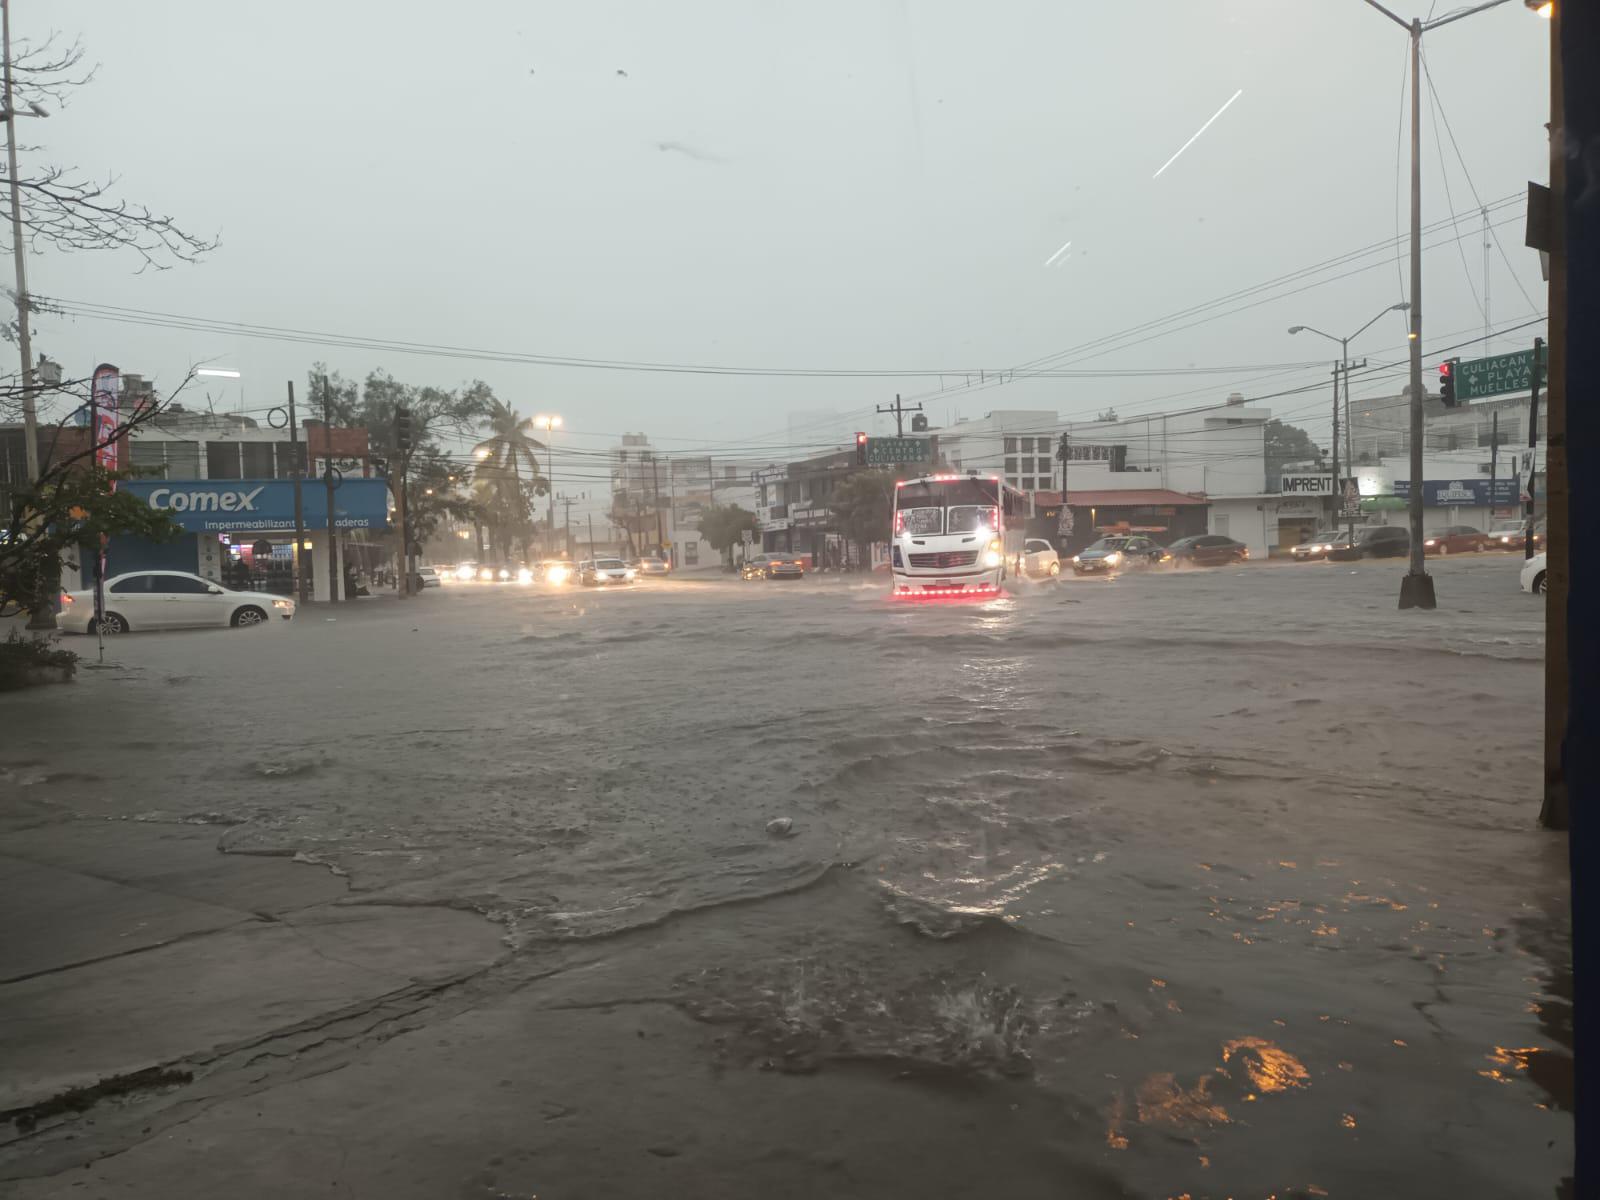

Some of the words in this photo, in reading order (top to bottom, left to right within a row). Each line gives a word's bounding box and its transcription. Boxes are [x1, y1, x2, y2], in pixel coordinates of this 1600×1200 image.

[1462, 355, 1526, 376] CULIACAN
[1487, 366, 1532, 382] PLAYA
[1470, 377, 1529, 396] MUELLES
[148, 486, 265, 512] Comex
[205, 519, 308, 530] Impermeabilizants
